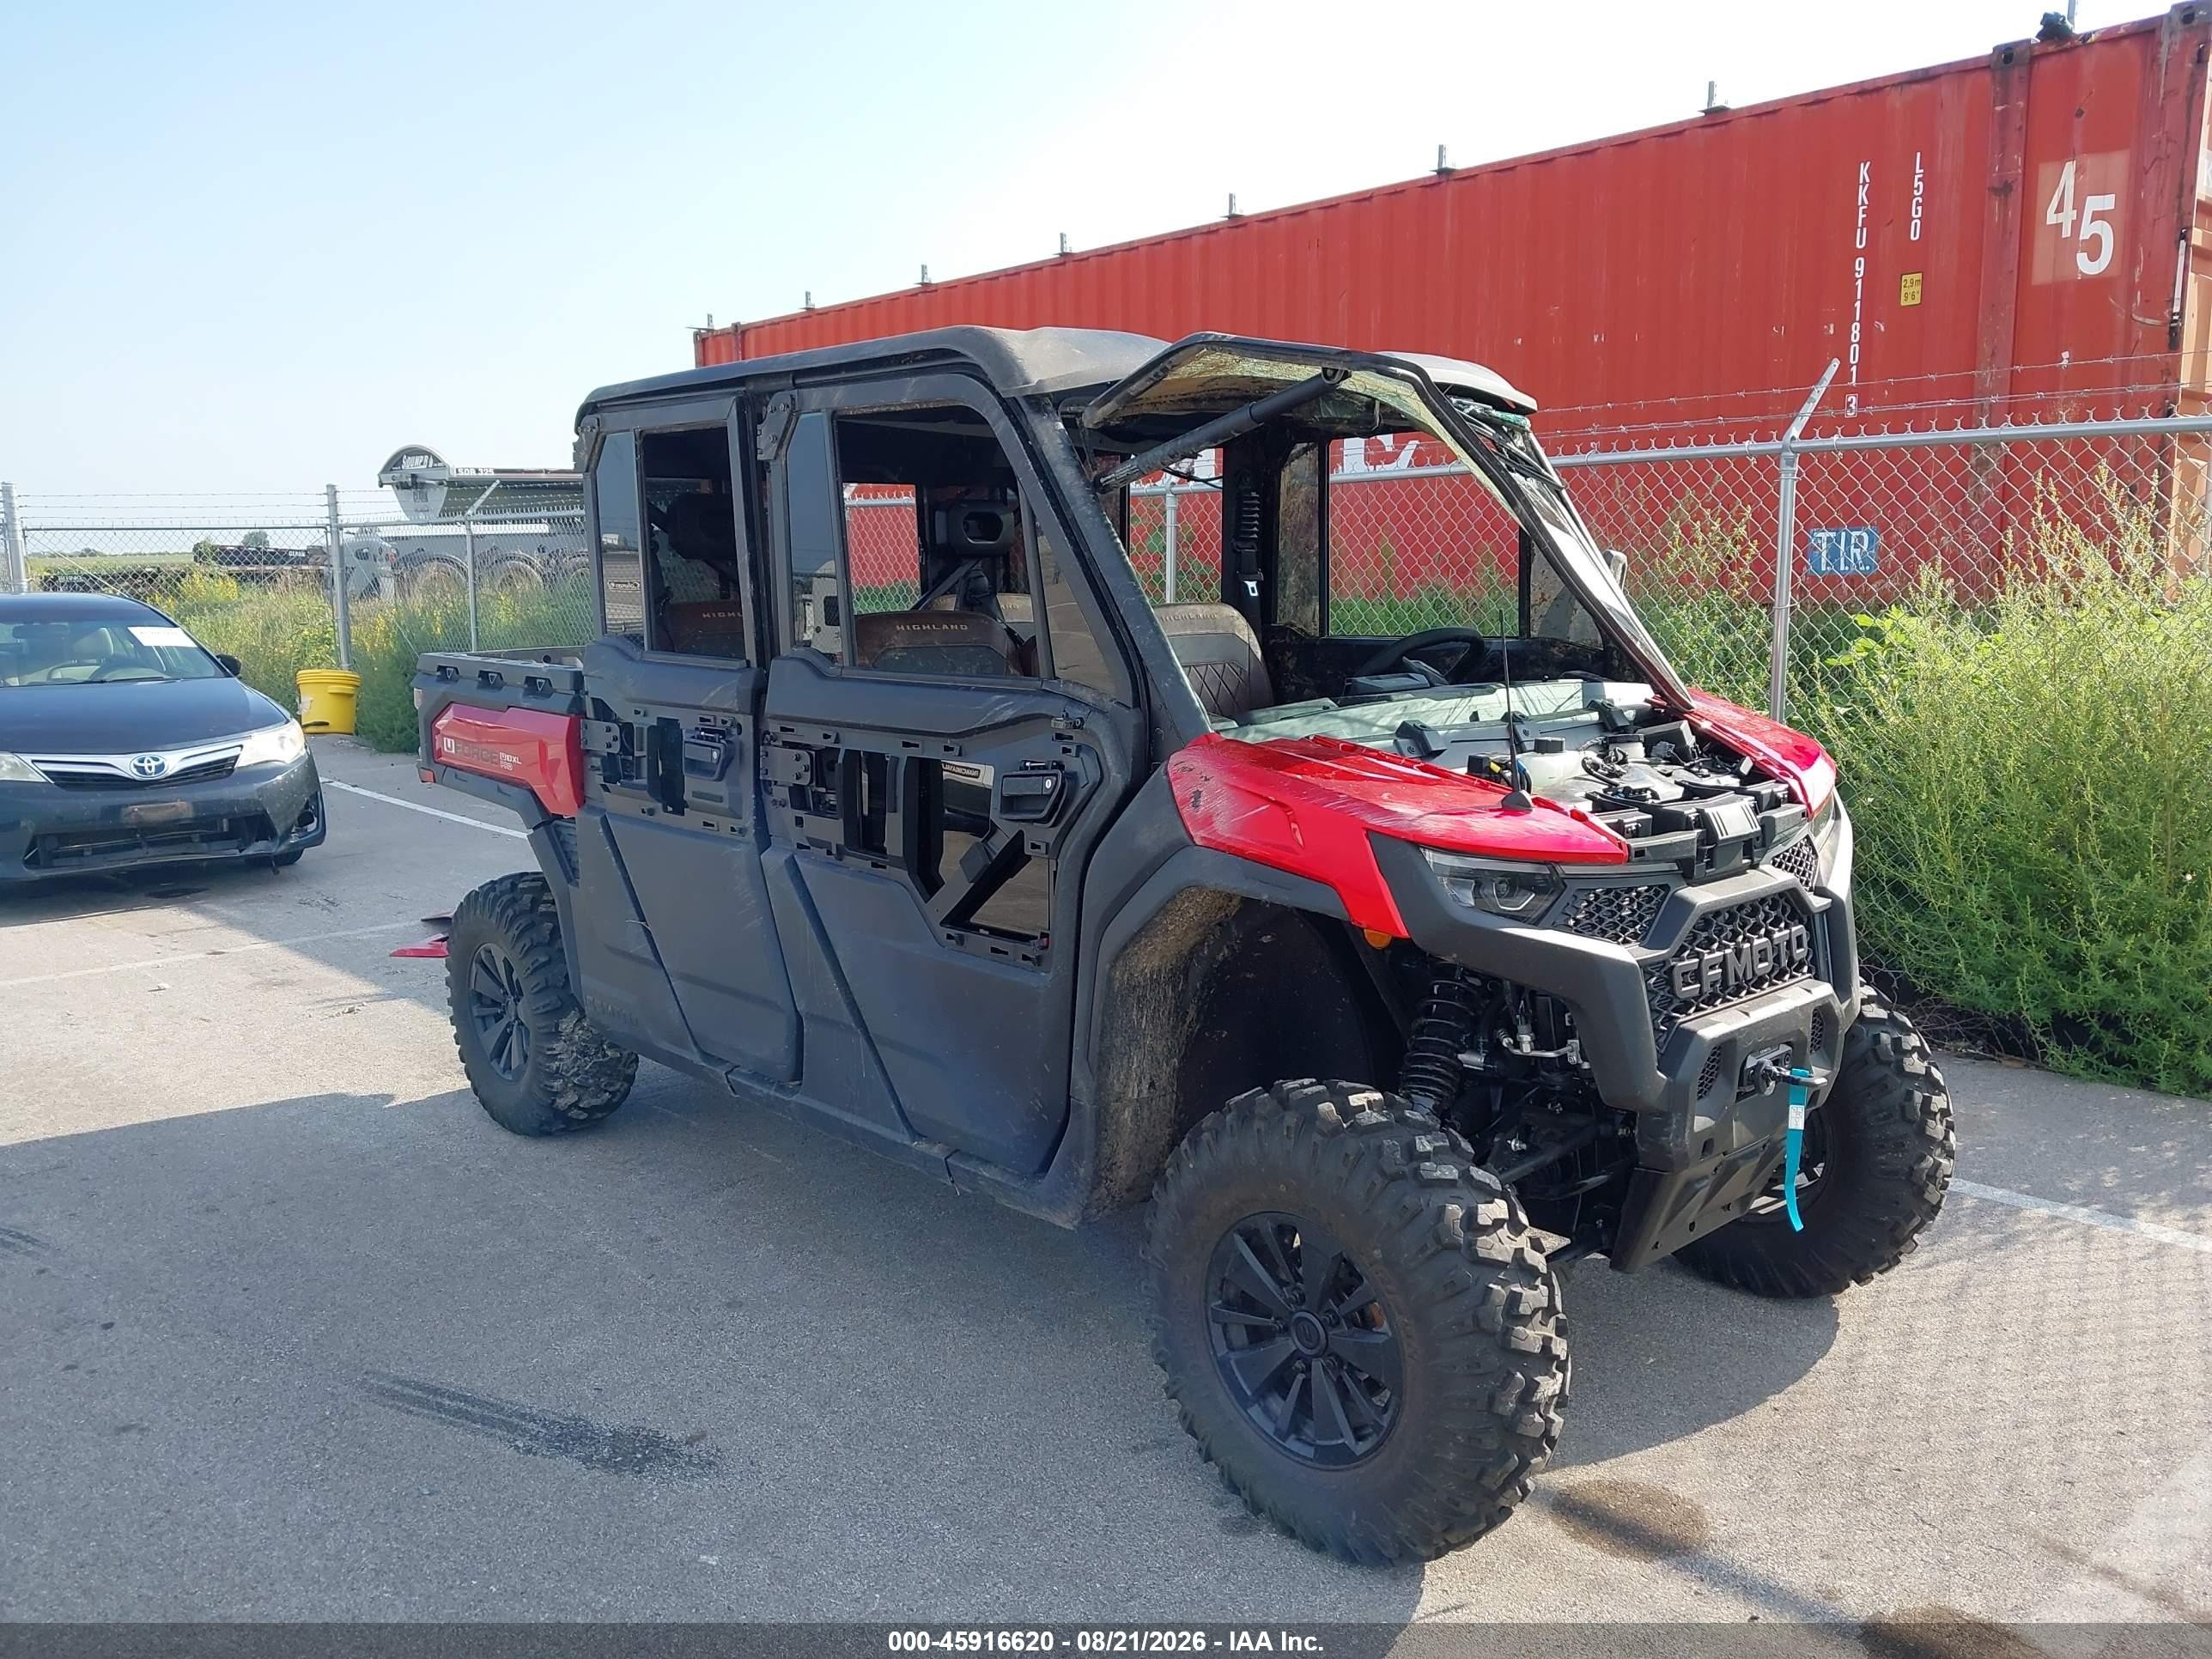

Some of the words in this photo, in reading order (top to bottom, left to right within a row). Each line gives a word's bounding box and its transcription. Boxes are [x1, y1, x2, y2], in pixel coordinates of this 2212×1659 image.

[1856, 161, 1871, 250] KKFU
[2046, 159, 2116, 276] 45
[1849, 257, 1865, 386] 911801
[1674, 924, 1808, 999] CFMOTO
